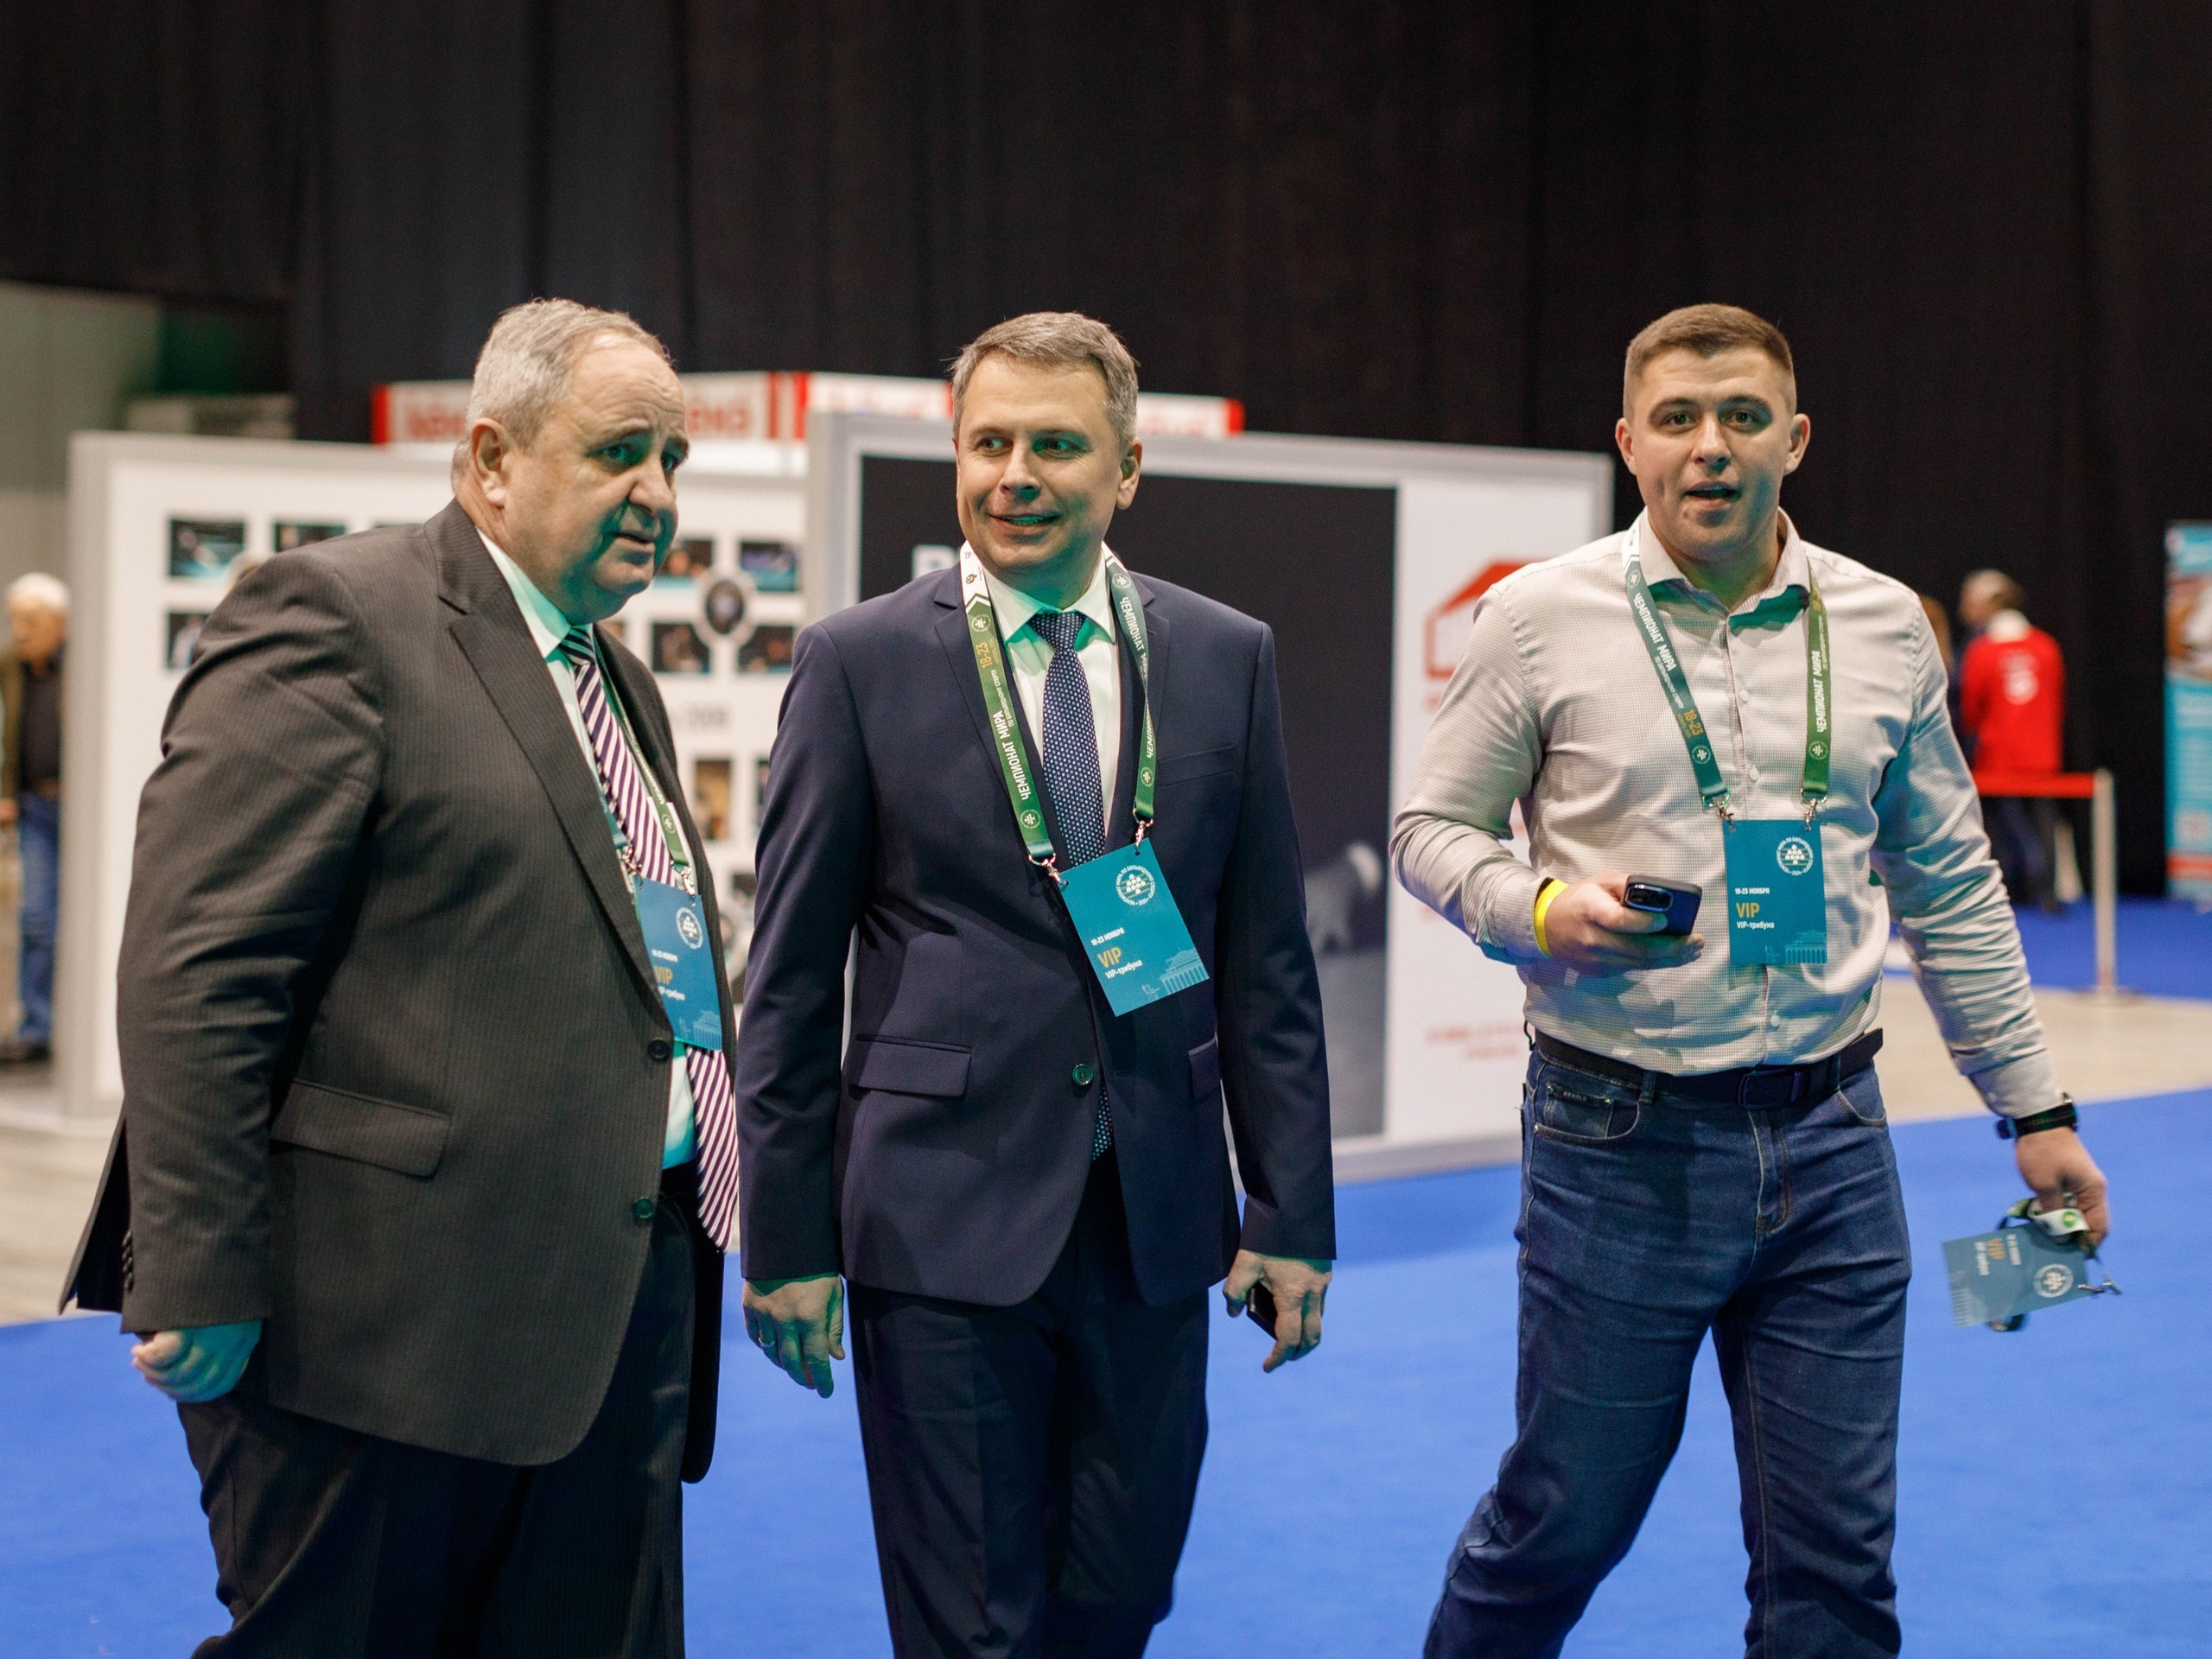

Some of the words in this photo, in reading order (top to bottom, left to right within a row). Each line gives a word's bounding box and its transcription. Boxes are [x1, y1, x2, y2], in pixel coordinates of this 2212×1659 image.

[1120, 596, 1144, 651] ЧЕМПИОНАТ
[1633, 593, 1663, 644] ЧЕМПИОНАТ
[1657, 645, 1676, 671] МИРА
[976, 643, 993, 668] 18-23
[1811, 650, 1822, 677] МИРА
[1814, 678, 1827, 733] ЧЕМПИОНАТ
[993, 710, 1010, 739] МИРА
[1684, 710, 1703, 735] 18-23
[1002, 742, 1031, 800] ЧЕМПИОНАТ
[1736, 902, 1760, 918] VIP
[1737, 920, 1775, 931] VIP-трибуна
[1096, 947, 1122, 968] VIP
[1105, 959, 1143, 979] VIP-трибуна
[654, 966, 673, 984] VIP
